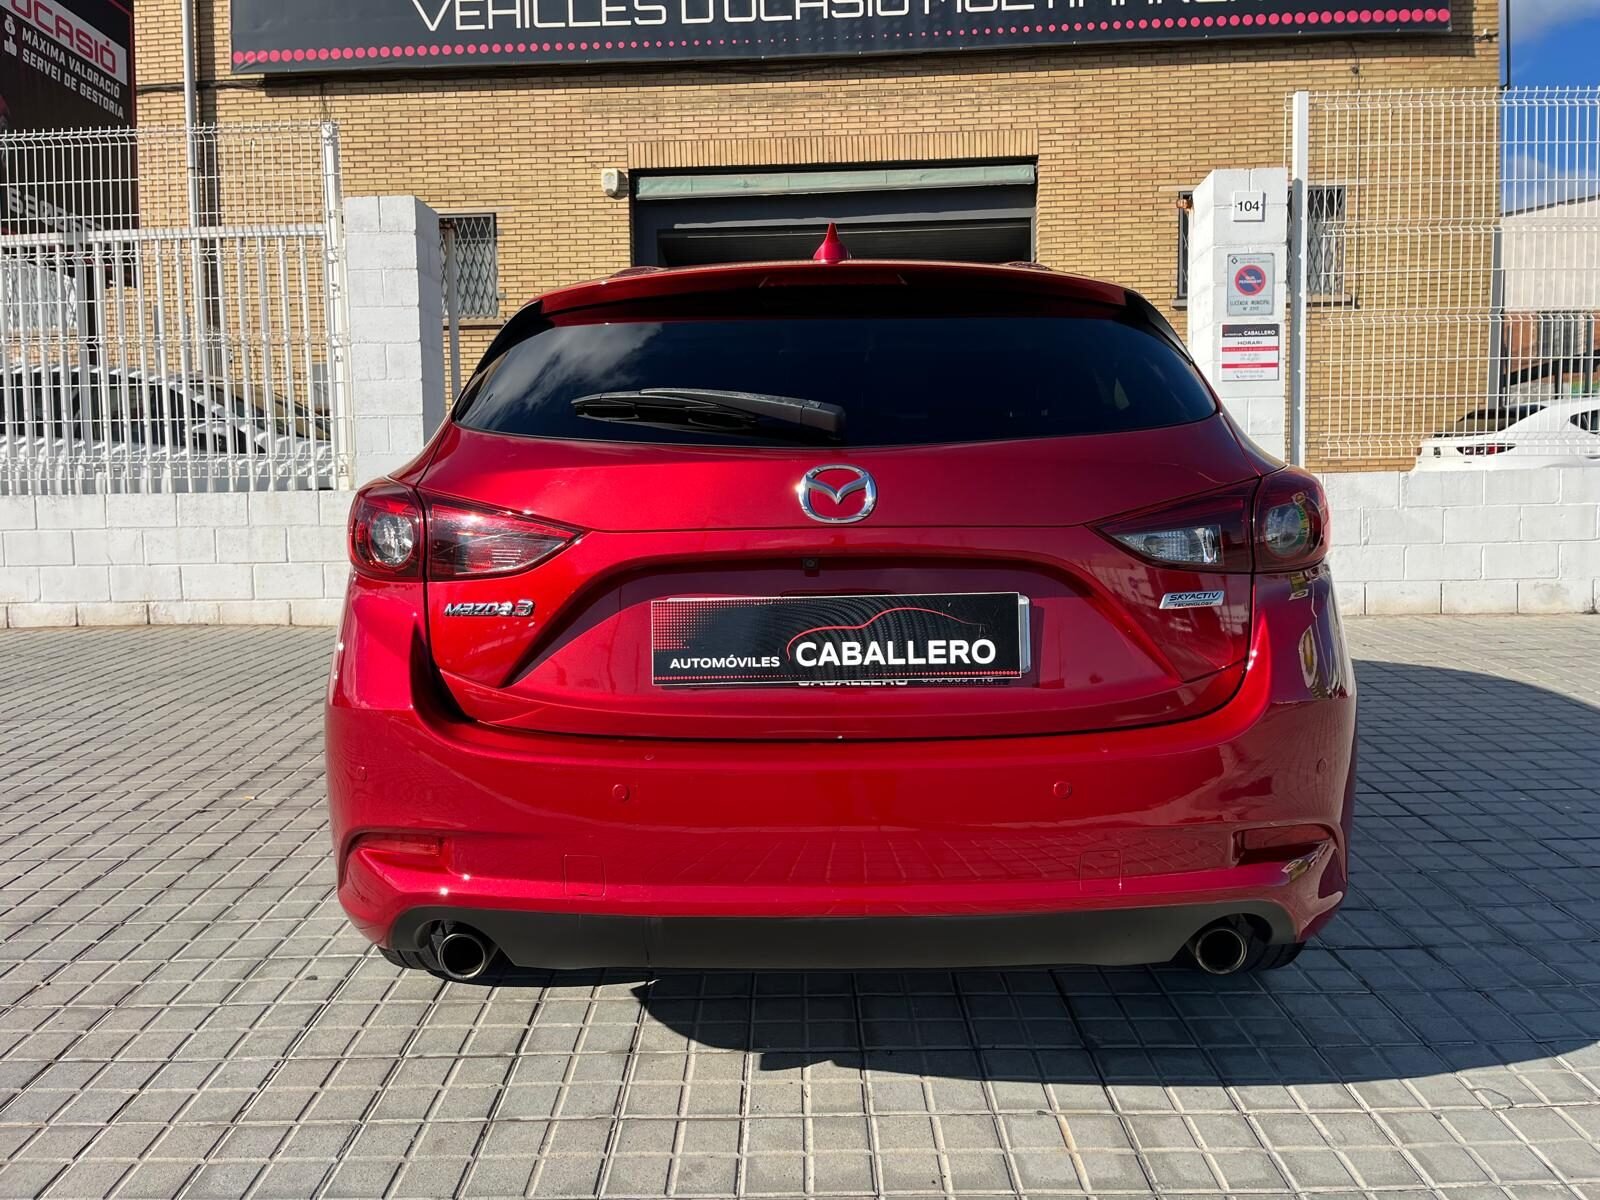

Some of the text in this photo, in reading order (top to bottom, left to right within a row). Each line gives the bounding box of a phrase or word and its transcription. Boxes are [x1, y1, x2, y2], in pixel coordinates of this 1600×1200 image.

[413, 0, 667, 32] VEHICLES
[22, 26, 121, 99] MÀXIMA VALORACIÓ
[22, 48, 125, 119] SERVEI DE GESTORIA
[1238, 200, 1260, 212] 104
[1169, 591, 1219, 601] SKYACTIV
[669, 638, 997, 669] AUTOMÓVILES CABALLERO
